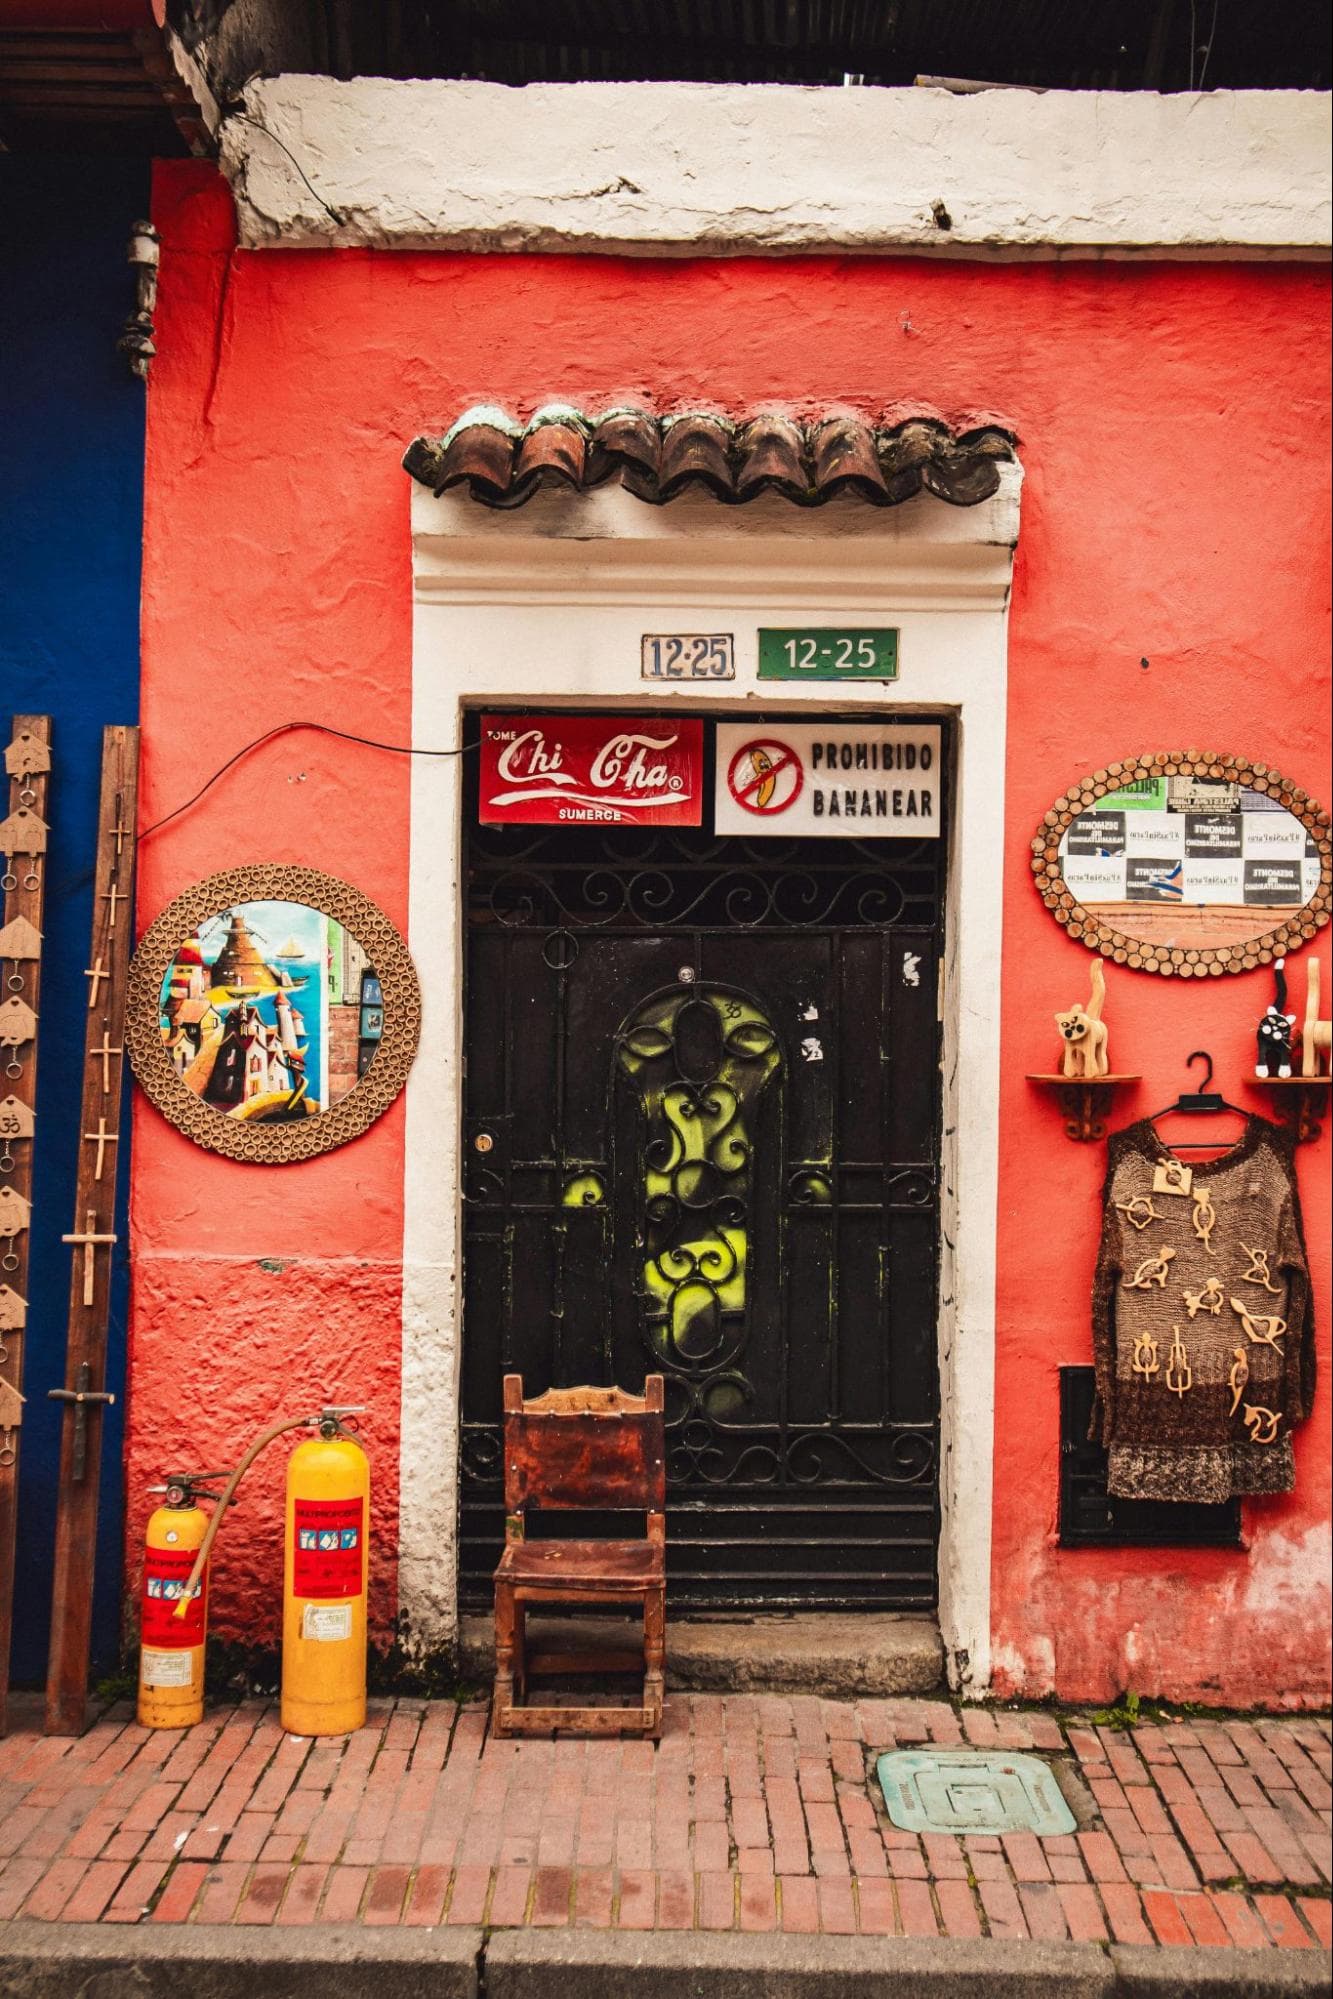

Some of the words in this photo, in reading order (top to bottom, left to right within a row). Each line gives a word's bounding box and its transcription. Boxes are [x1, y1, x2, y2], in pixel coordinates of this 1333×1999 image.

[784, 638, 876, 669] 12-25
[498, 730, 578, 785] Chi
[812, 743, 932, 770] PROHIBIDO
[813, 789, 932, 817] BANANEAR
